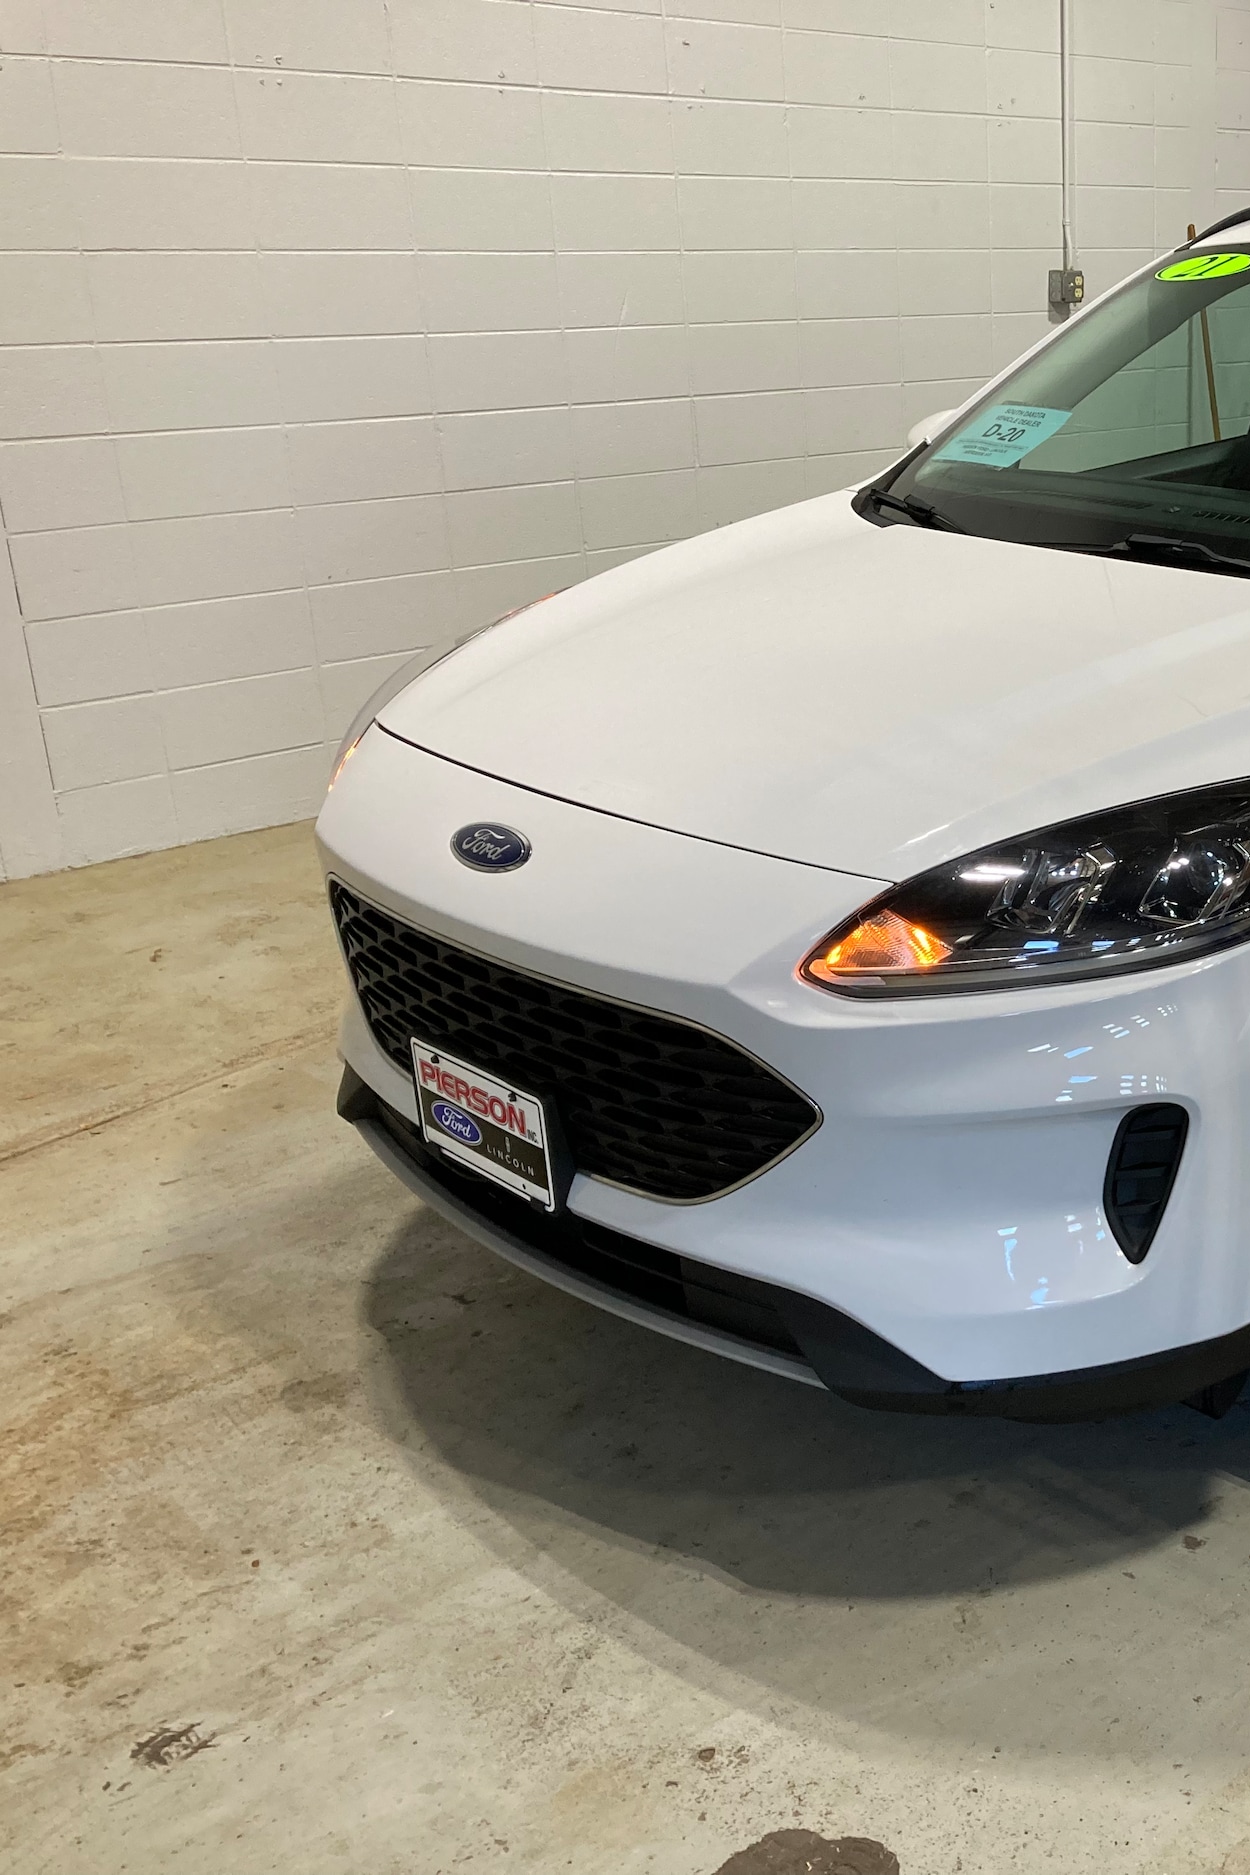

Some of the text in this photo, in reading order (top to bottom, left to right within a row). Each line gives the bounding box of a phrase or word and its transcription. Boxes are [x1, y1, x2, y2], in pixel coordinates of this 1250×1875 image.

[1169, 255, 1240, 279] 21
[1004, 408, 1046, 419] SOUTH DAKOTA
[1017, 418, 1042, 428] DEALER
[982, 423, 1026, 442] D-20
[461, 828, 511, 860] Ford
[419, 1058, 527, 1137] PIERSON
[441, 1106, 472, 1139] Ford
[486, 1144, 535, 1177] LINCOLN
